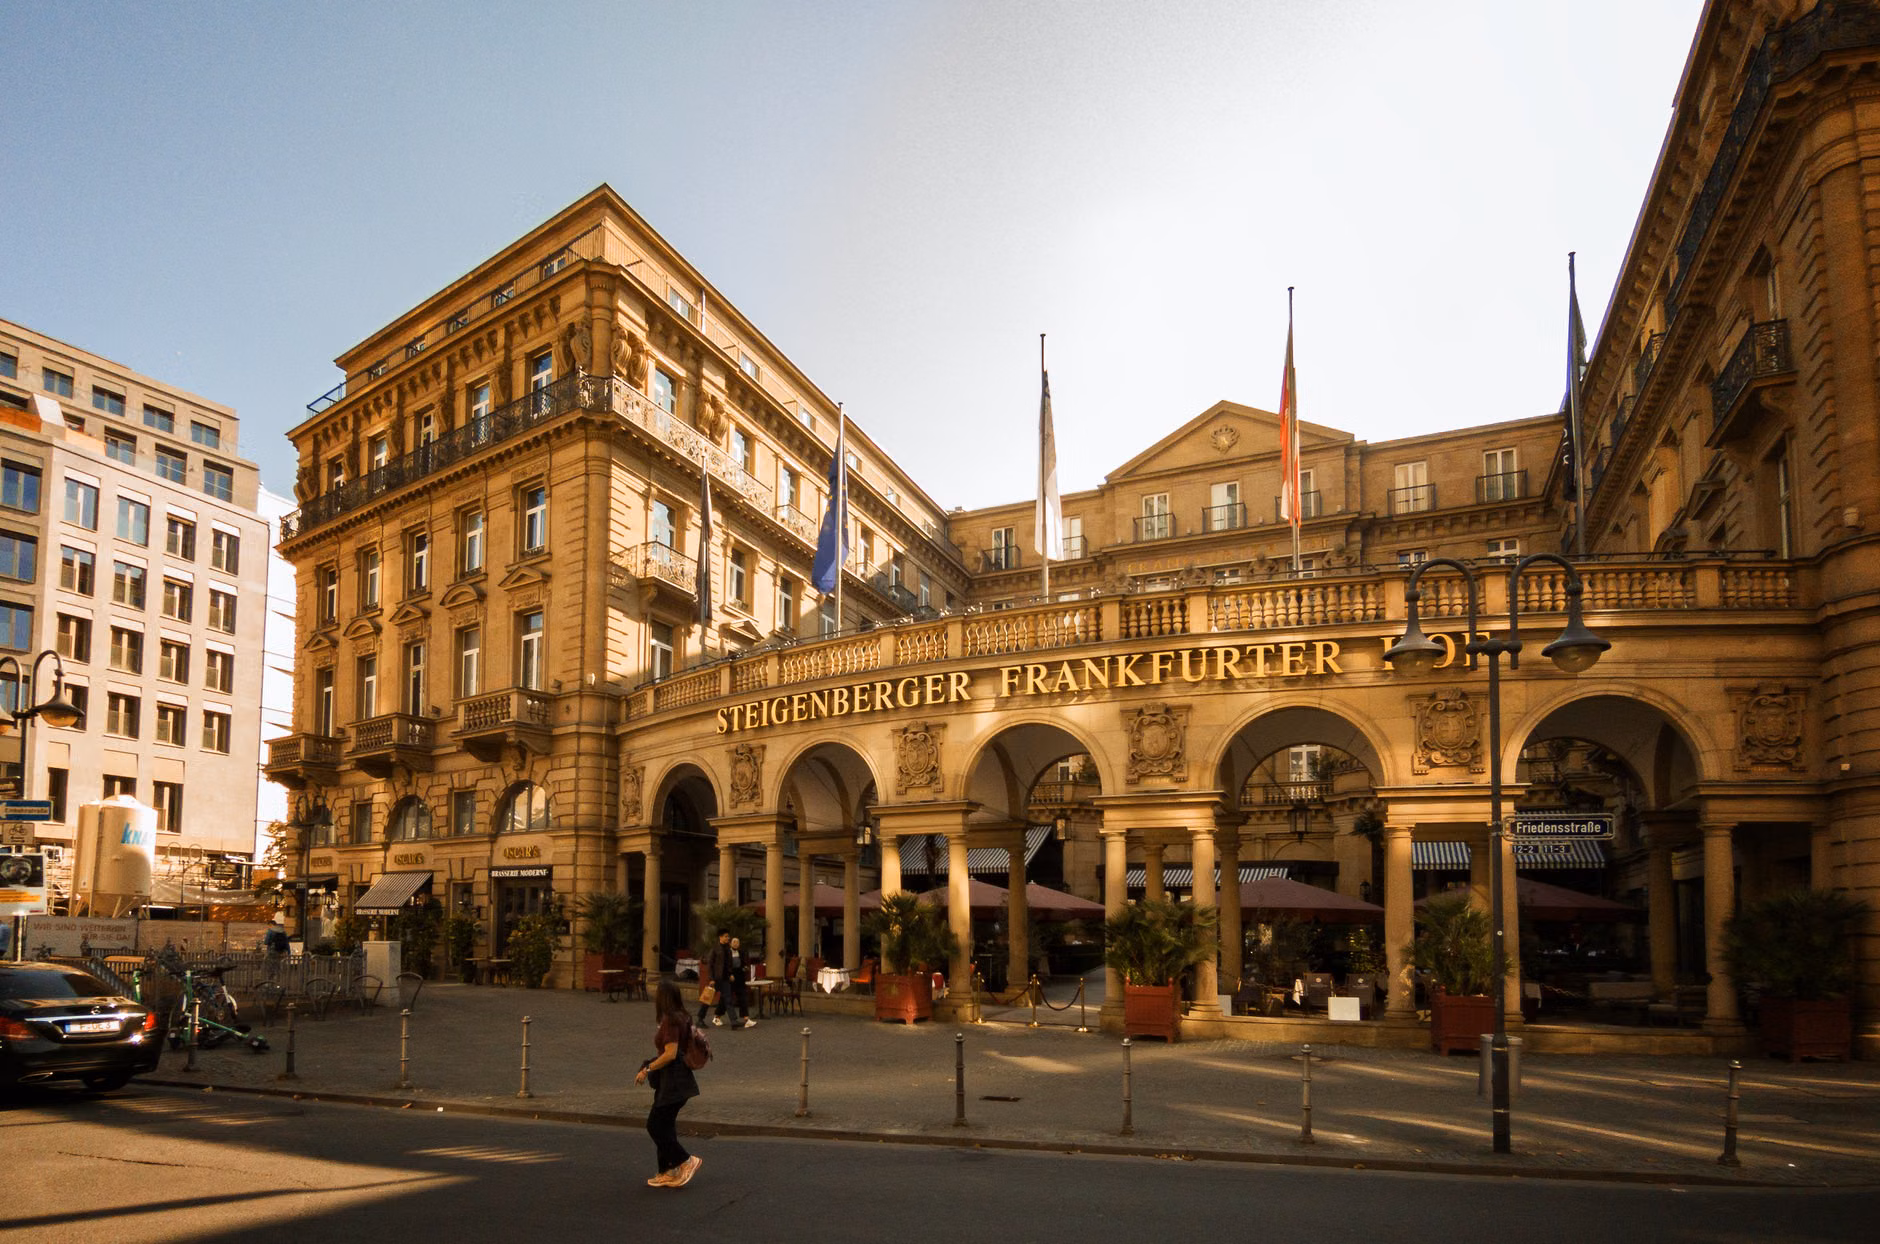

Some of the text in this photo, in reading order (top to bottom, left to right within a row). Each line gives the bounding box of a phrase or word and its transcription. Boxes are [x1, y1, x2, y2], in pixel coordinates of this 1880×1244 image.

[717, 671, 971, 734] STEIGENBERGER
[1000, 641, 1343, 697] FRANKFURTER
[1516, 821, 1601, 833] Friedensstraße
[1513, 845, 1565, 854] 12-2 11-3
[56, 922, 77, 931] SIND
